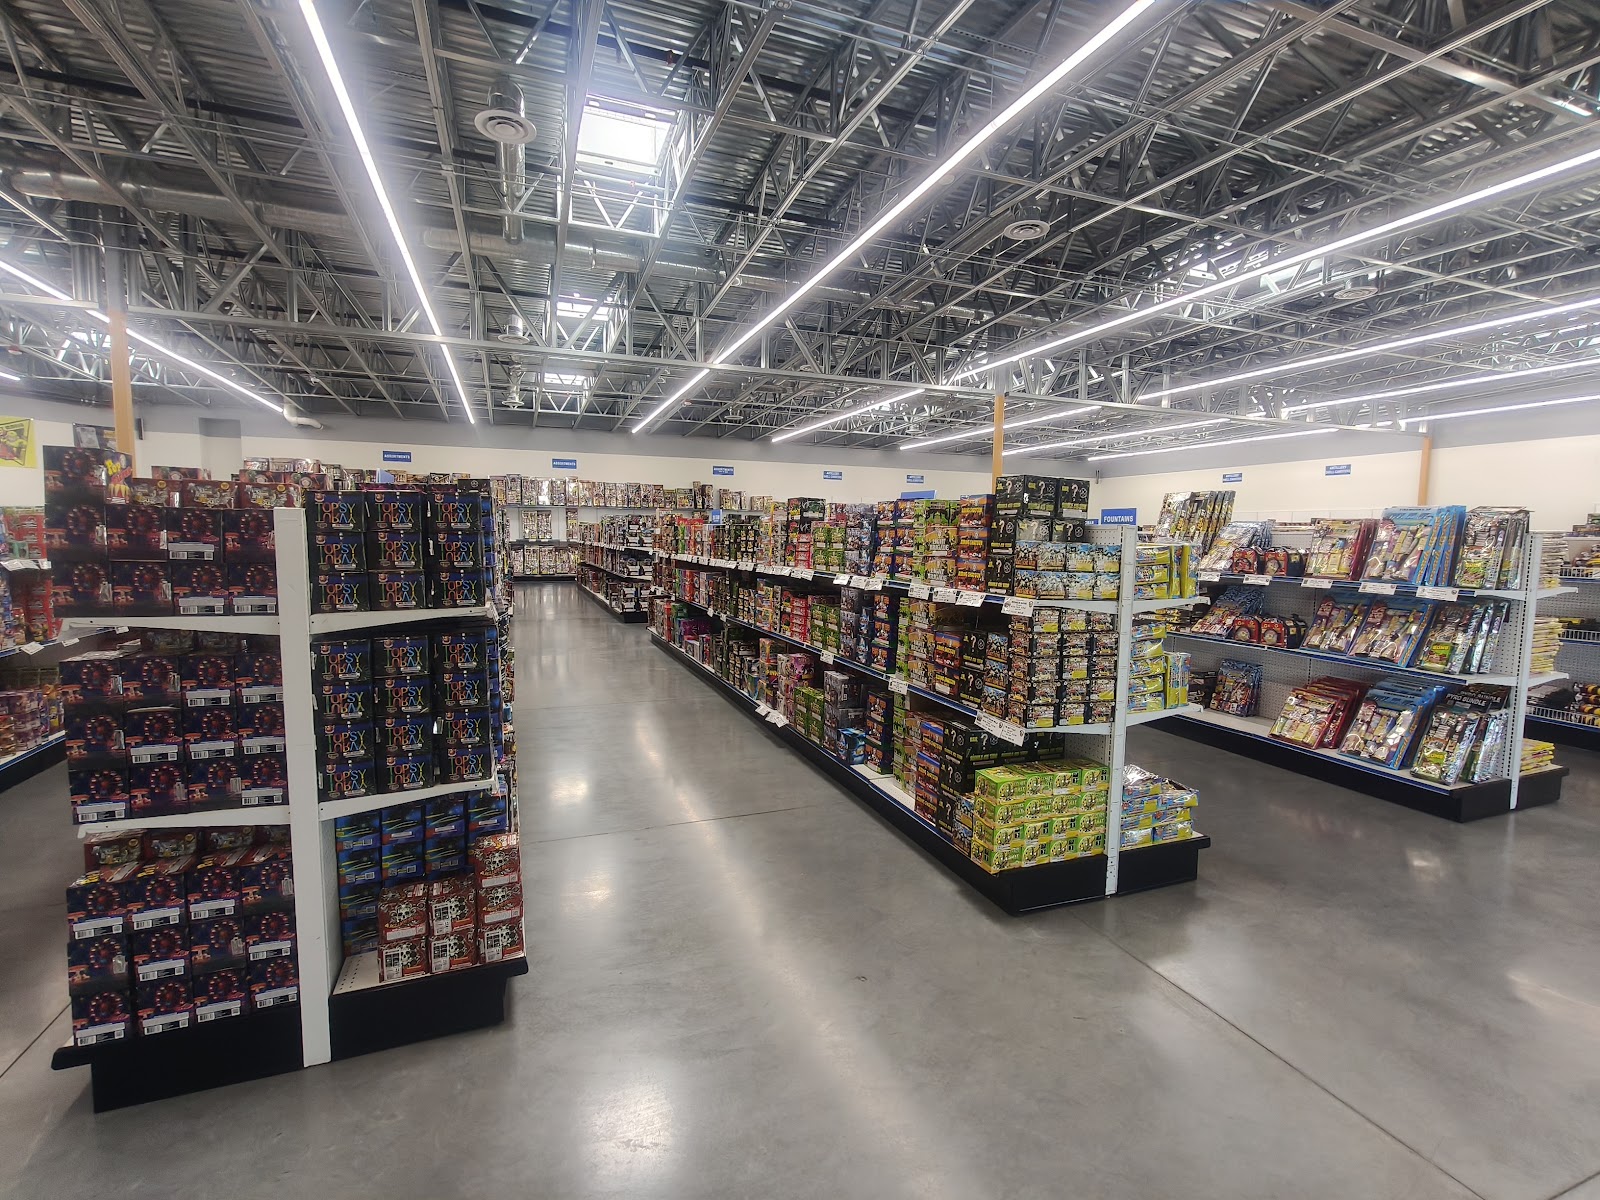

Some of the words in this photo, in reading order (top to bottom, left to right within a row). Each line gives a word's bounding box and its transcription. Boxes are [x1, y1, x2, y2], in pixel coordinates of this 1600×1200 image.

[315, 502, 355, 512] TOPSY
[375, 502, 413, 512] TOPSY
[434, 502, 472, 512] TOPSY
[317, 544, 357, 554] TOPSY
[378, 541, 416, 551] TOPSY
[438, 541, 474, 551] TOPSY
[318, 583, 359, 593] TOPSY
[379, 581, 416, 591] TOPSY
[440, 580, 477, 590] TOPSY
[384, 647, 422, 657] TOPSY
[442, 643, 478, 653] TOPSY
[320, 652, 361, 664] TOPSY
[444, 680, 480, 690] TOPSY
[385, 686, 423, 697] TOPSY
[322, 692, 363, 702] TOPSY
[1462, 696, 1486, 706] BUNDLE
[444, 718, 481, 729] TOPSY
[385, 725, 423, 735] TOPSY
[325, 730, 365, 742] TOPSY
[448, 754, 483, 765] TOPSY
[386, 762, 424, 773] TOPSY
[325, 769, 366, 780] TOPSY
